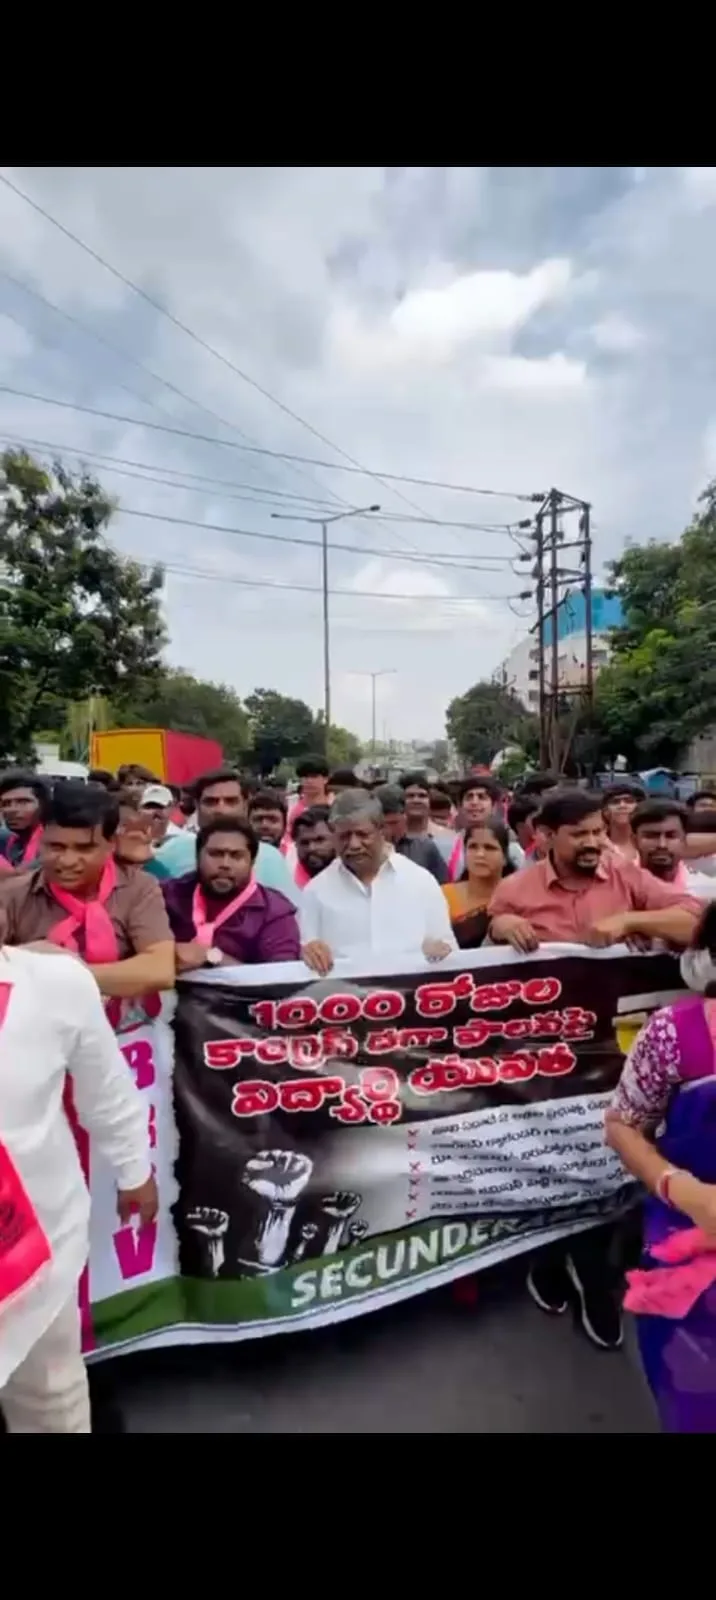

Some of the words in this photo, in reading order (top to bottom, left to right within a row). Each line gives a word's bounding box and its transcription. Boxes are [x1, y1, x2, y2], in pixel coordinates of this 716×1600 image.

[249, 990, 405, 1029] 1000
[415, 973, 562, 1018] రోజుల
[204, 1026, 358, 1070] కాంగ్రెస్
[407, 1042, 577, 1096] యువత
[291, 1212, 556, 1307] SECUNDER
